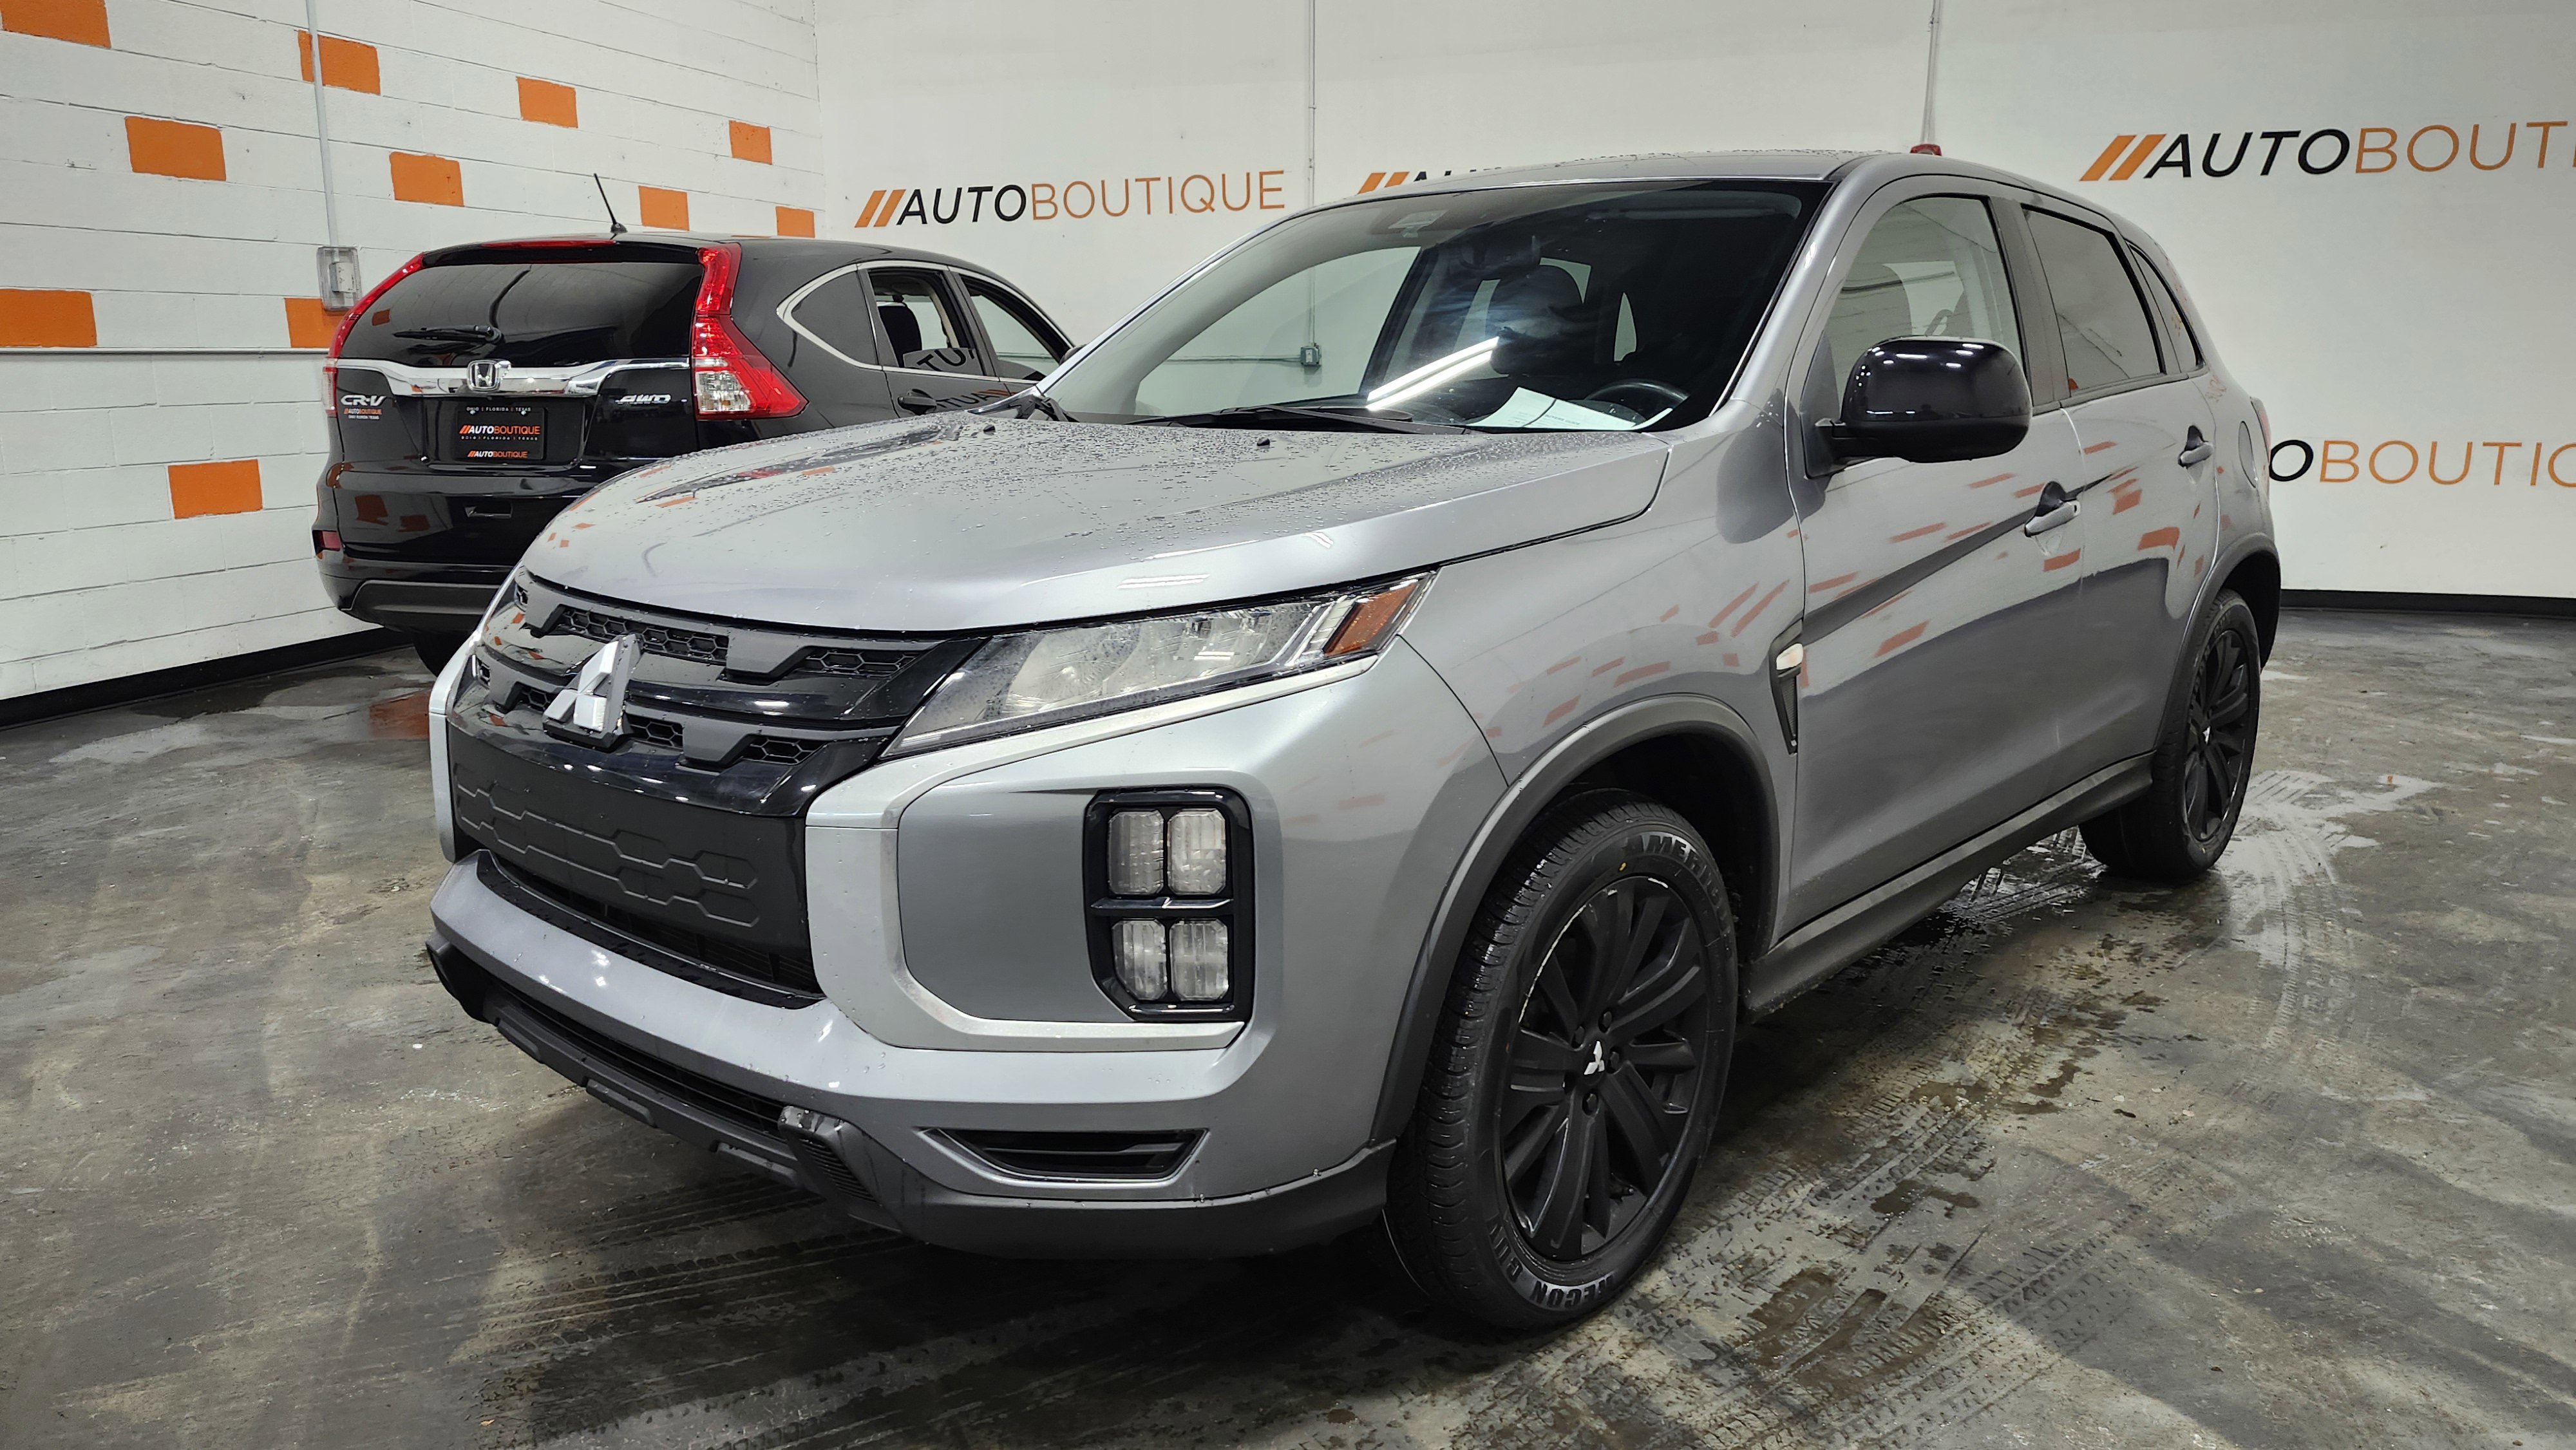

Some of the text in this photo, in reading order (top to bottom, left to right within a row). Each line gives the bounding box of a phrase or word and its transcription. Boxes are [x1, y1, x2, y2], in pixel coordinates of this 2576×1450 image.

[896, 170, 1285, 225] AUTOBOUTIQUE
[341, 394, 386, 406] CR-V
[620, 394, 671, 404] AWD
[468, 426, 541, 435] AUTOBOUTIQUE
